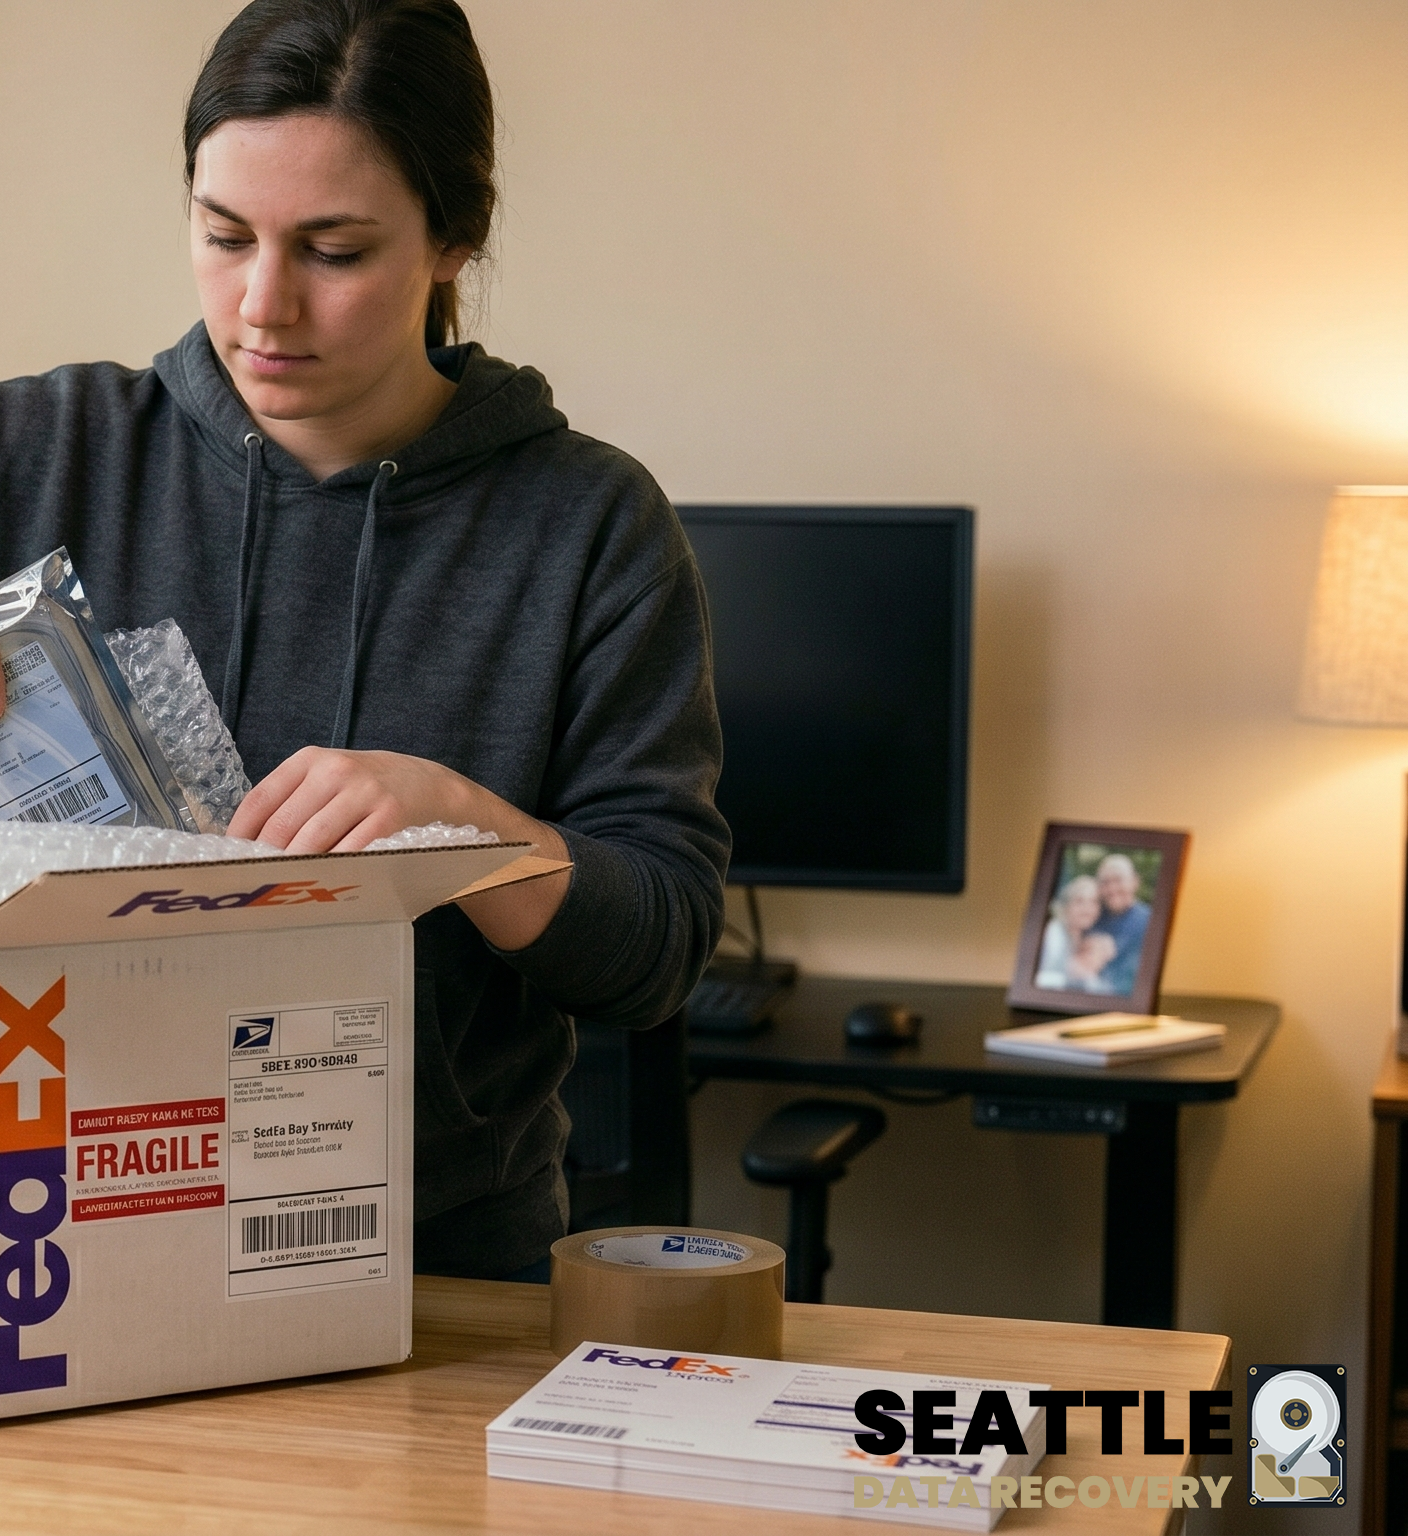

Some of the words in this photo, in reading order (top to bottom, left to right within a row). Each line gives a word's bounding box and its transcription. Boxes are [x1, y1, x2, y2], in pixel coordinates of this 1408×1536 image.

[107, 880, 362, 918] FedEx
[76, 1133, 219, 1181] FRAGILE
[582, 1348, 740, 1377] FedEx
